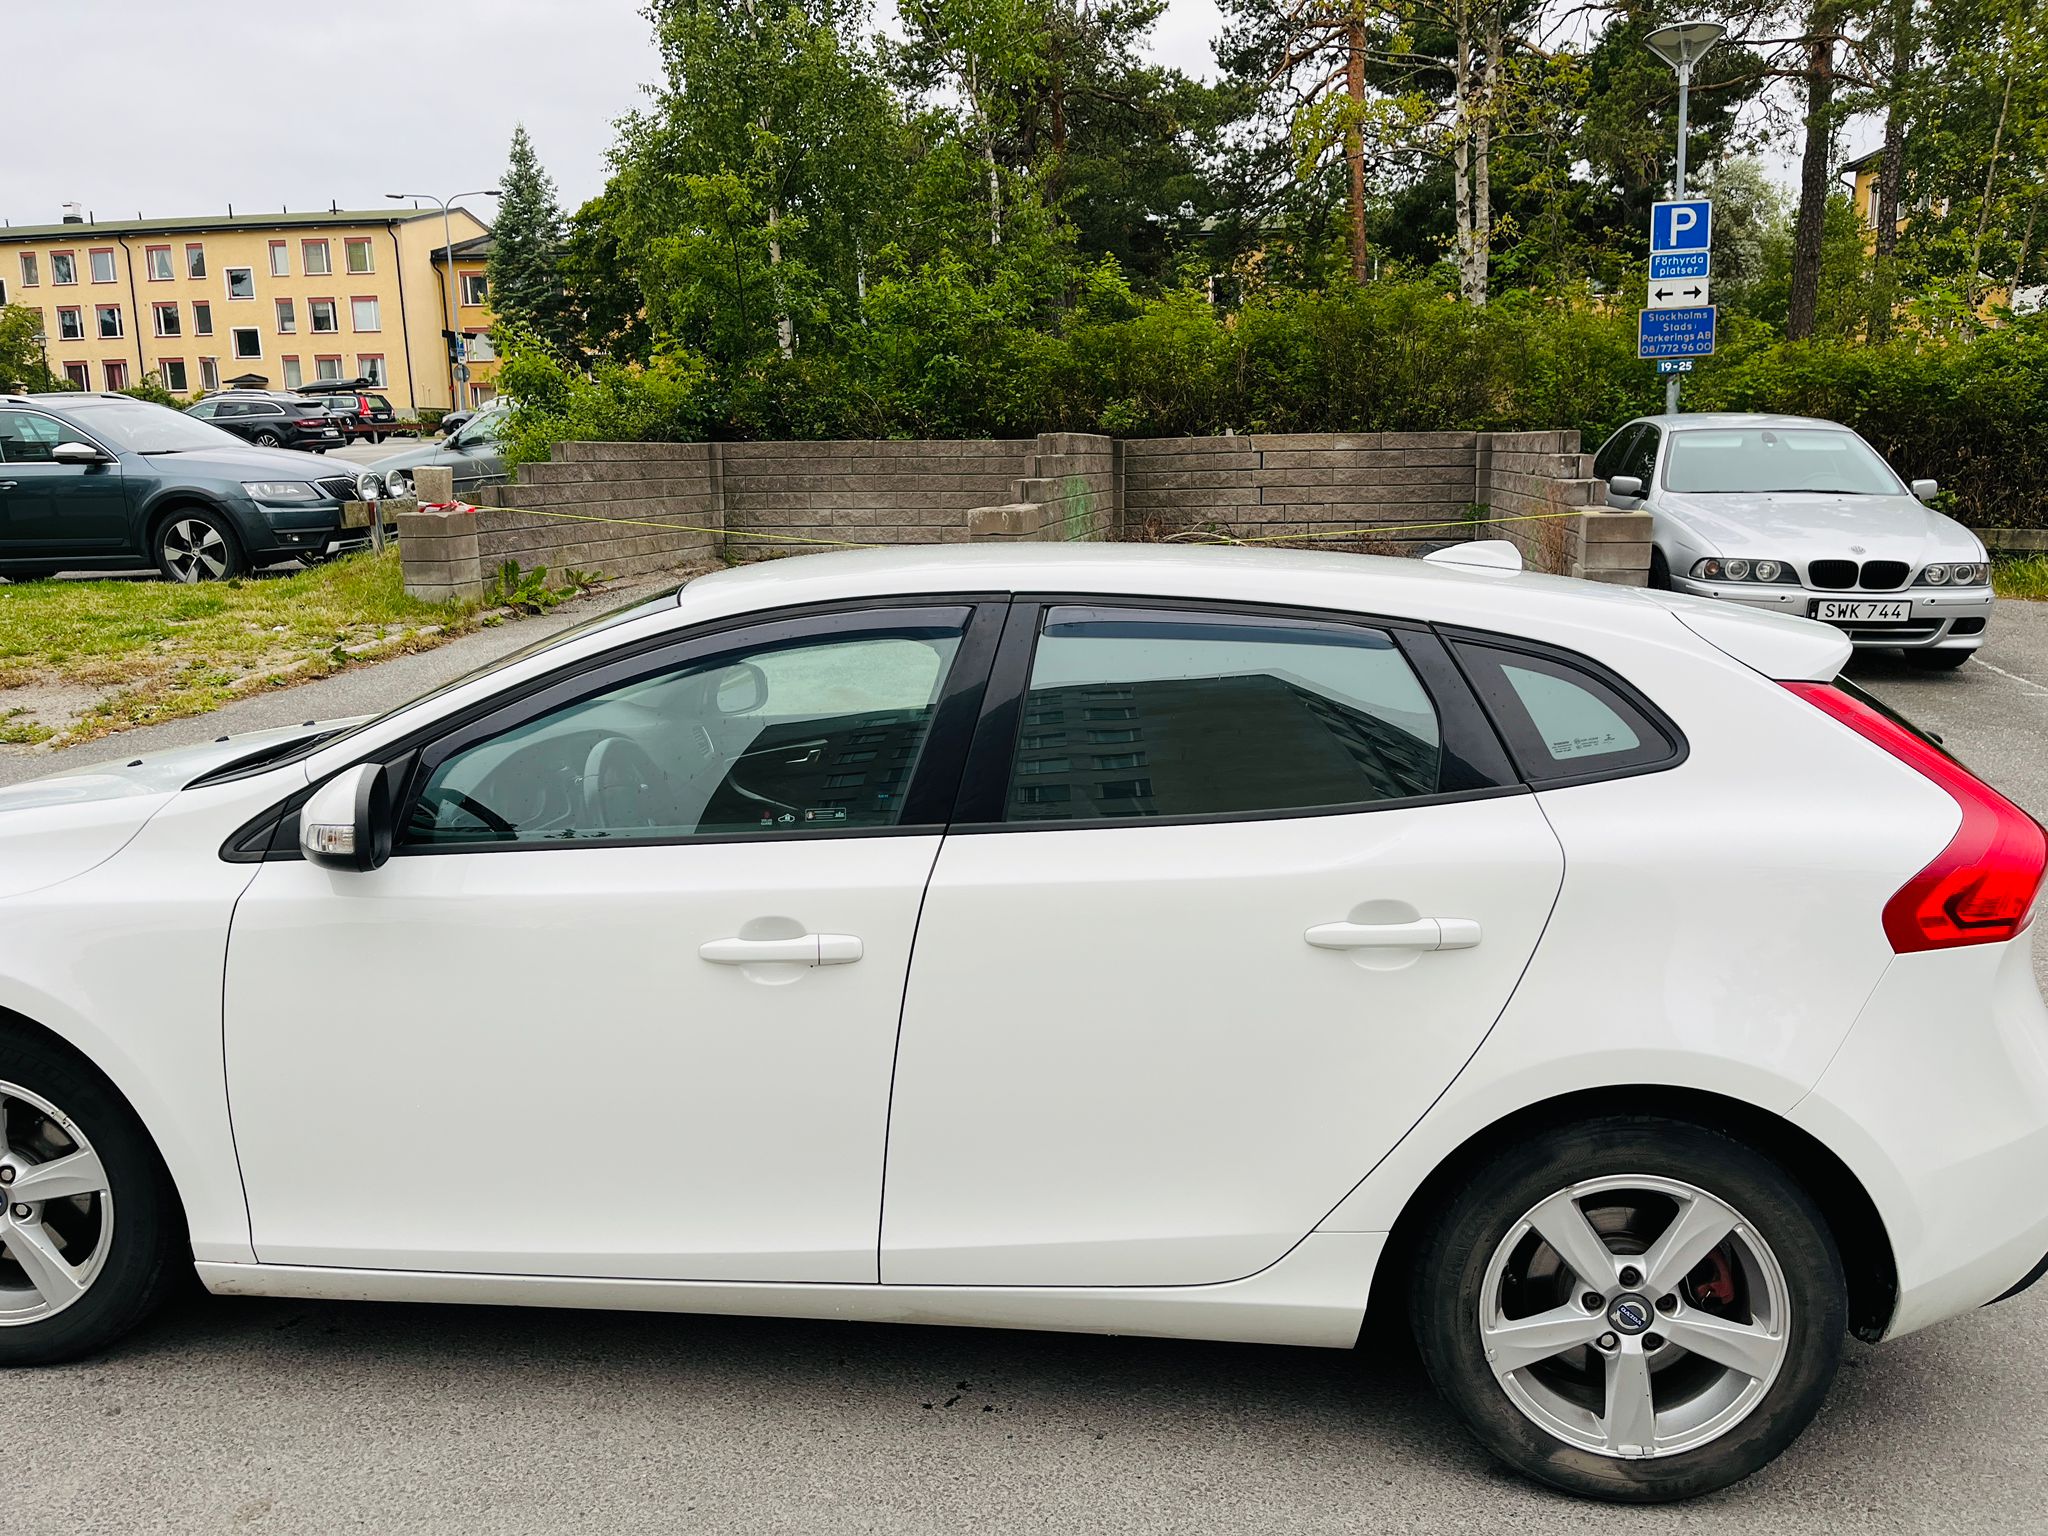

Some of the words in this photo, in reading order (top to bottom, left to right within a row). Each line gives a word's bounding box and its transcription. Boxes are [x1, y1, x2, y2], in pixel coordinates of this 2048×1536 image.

[1669, 207, 1697, 247] P
[1655, 255, 1704, 268] Förhyrda
[1659, 266, 1698, 277] platser
[1648, 311, 1708, 322] Stockholms
[1642, 332, 1695, 343] Parkerings
[1697, 331, 1711, 340] AB
[1641, 344, 1679, 354] 08/772
[1681, 343, 1694, 352] 96
[1696, 342, 1711, 351] 00
[1661, 361, 1693, 372] 19-25
[1825, 603, 1860, 619] SWK
[1867, 604, 1902, 619] 744
[1620, 1307, 1642, 1326] VOLVO
